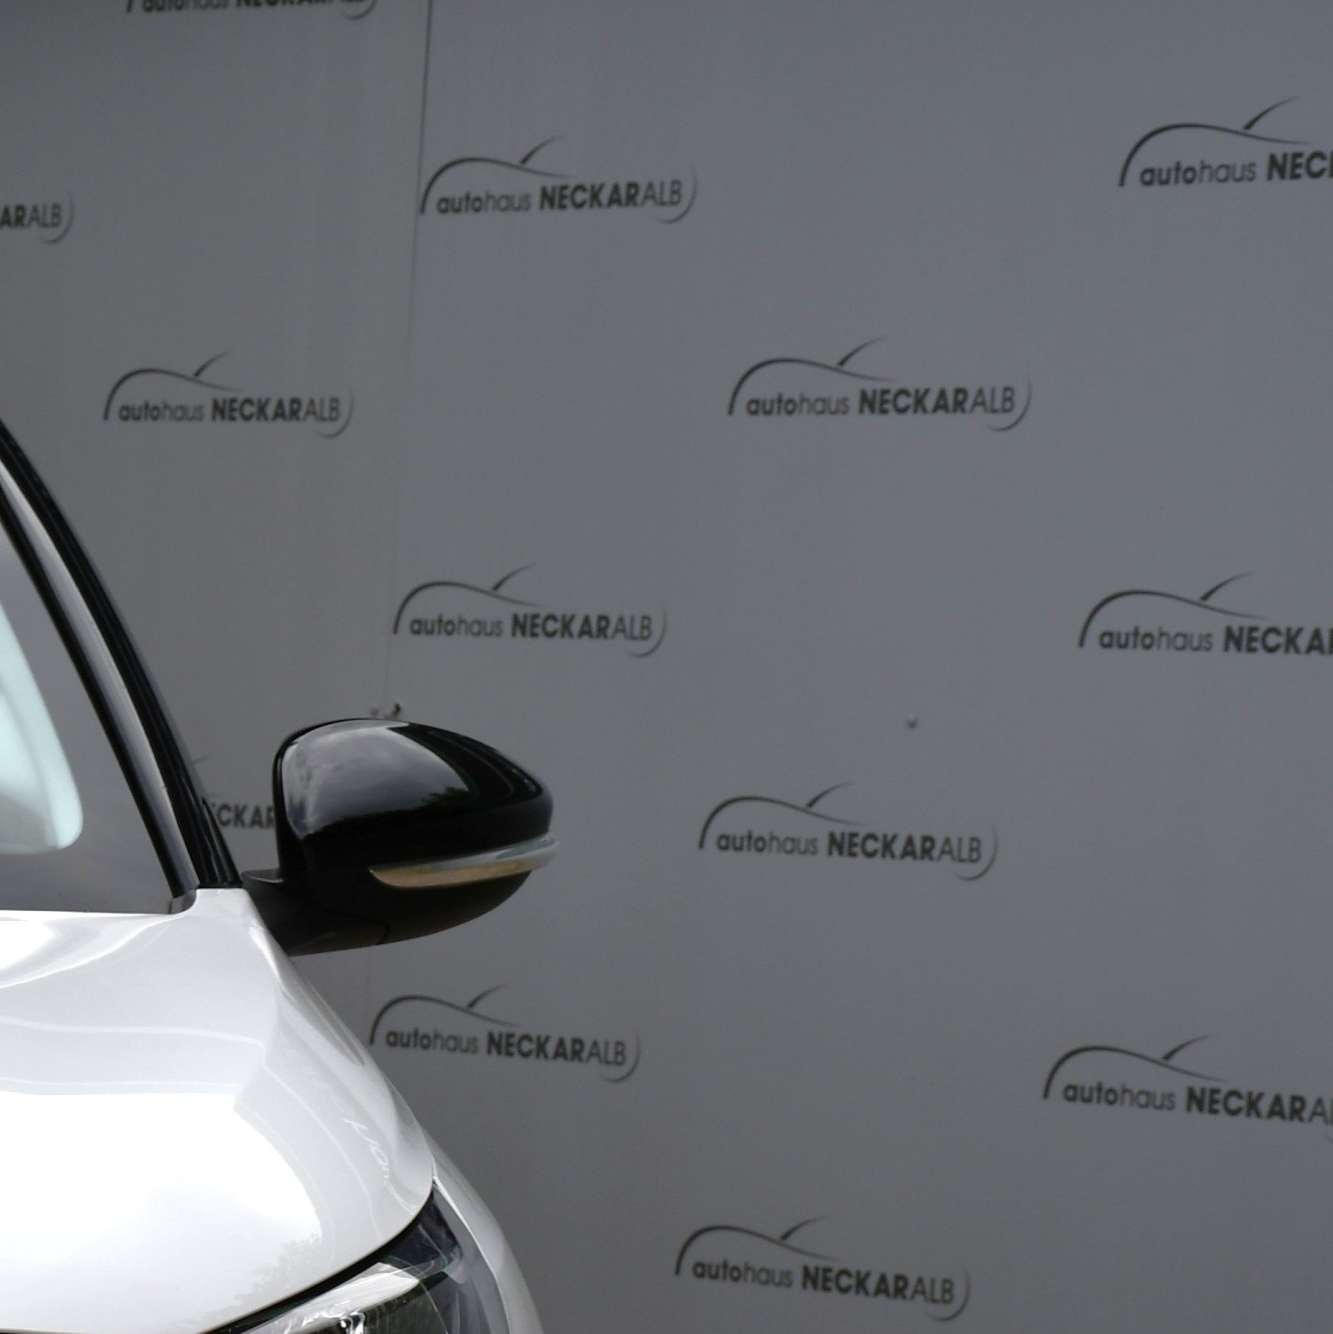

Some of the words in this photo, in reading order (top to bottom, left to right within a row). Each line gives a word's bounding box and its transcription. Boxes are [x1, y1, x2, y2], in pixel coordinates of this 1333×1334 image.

[1140, 160, 1257, 187] autohaus
[437, 190, 530, 214] autohaus
[540, 180, 681, 210] NECKARALB
[119, 400, 204, 423] autohaus
[212, 398, 339, 423] NECKARALB
[746, 391, 849, 417] autohaus
[859, 387, 1015, 415] NECKARALB
[410, 614, 502, 638] autohaus
[512, 613, 652, 642] NECKARALB
[1099, 626, 1213, 652] autohaus
[1224, 625, 1333, 655] NECKA
[717, 828, 819, 855] autohaus
[827, 830, 981, 863] NECKARALB
[386, 1027, 479, 1054] autohaus
[486, 1031, 626, 1067] NECKARALB
[1063, 1081, 1175, 1112] autohaus
[692, 1257, 793, 1288] autohaus
[801, 1264, 954, 1306] NECKARALB
